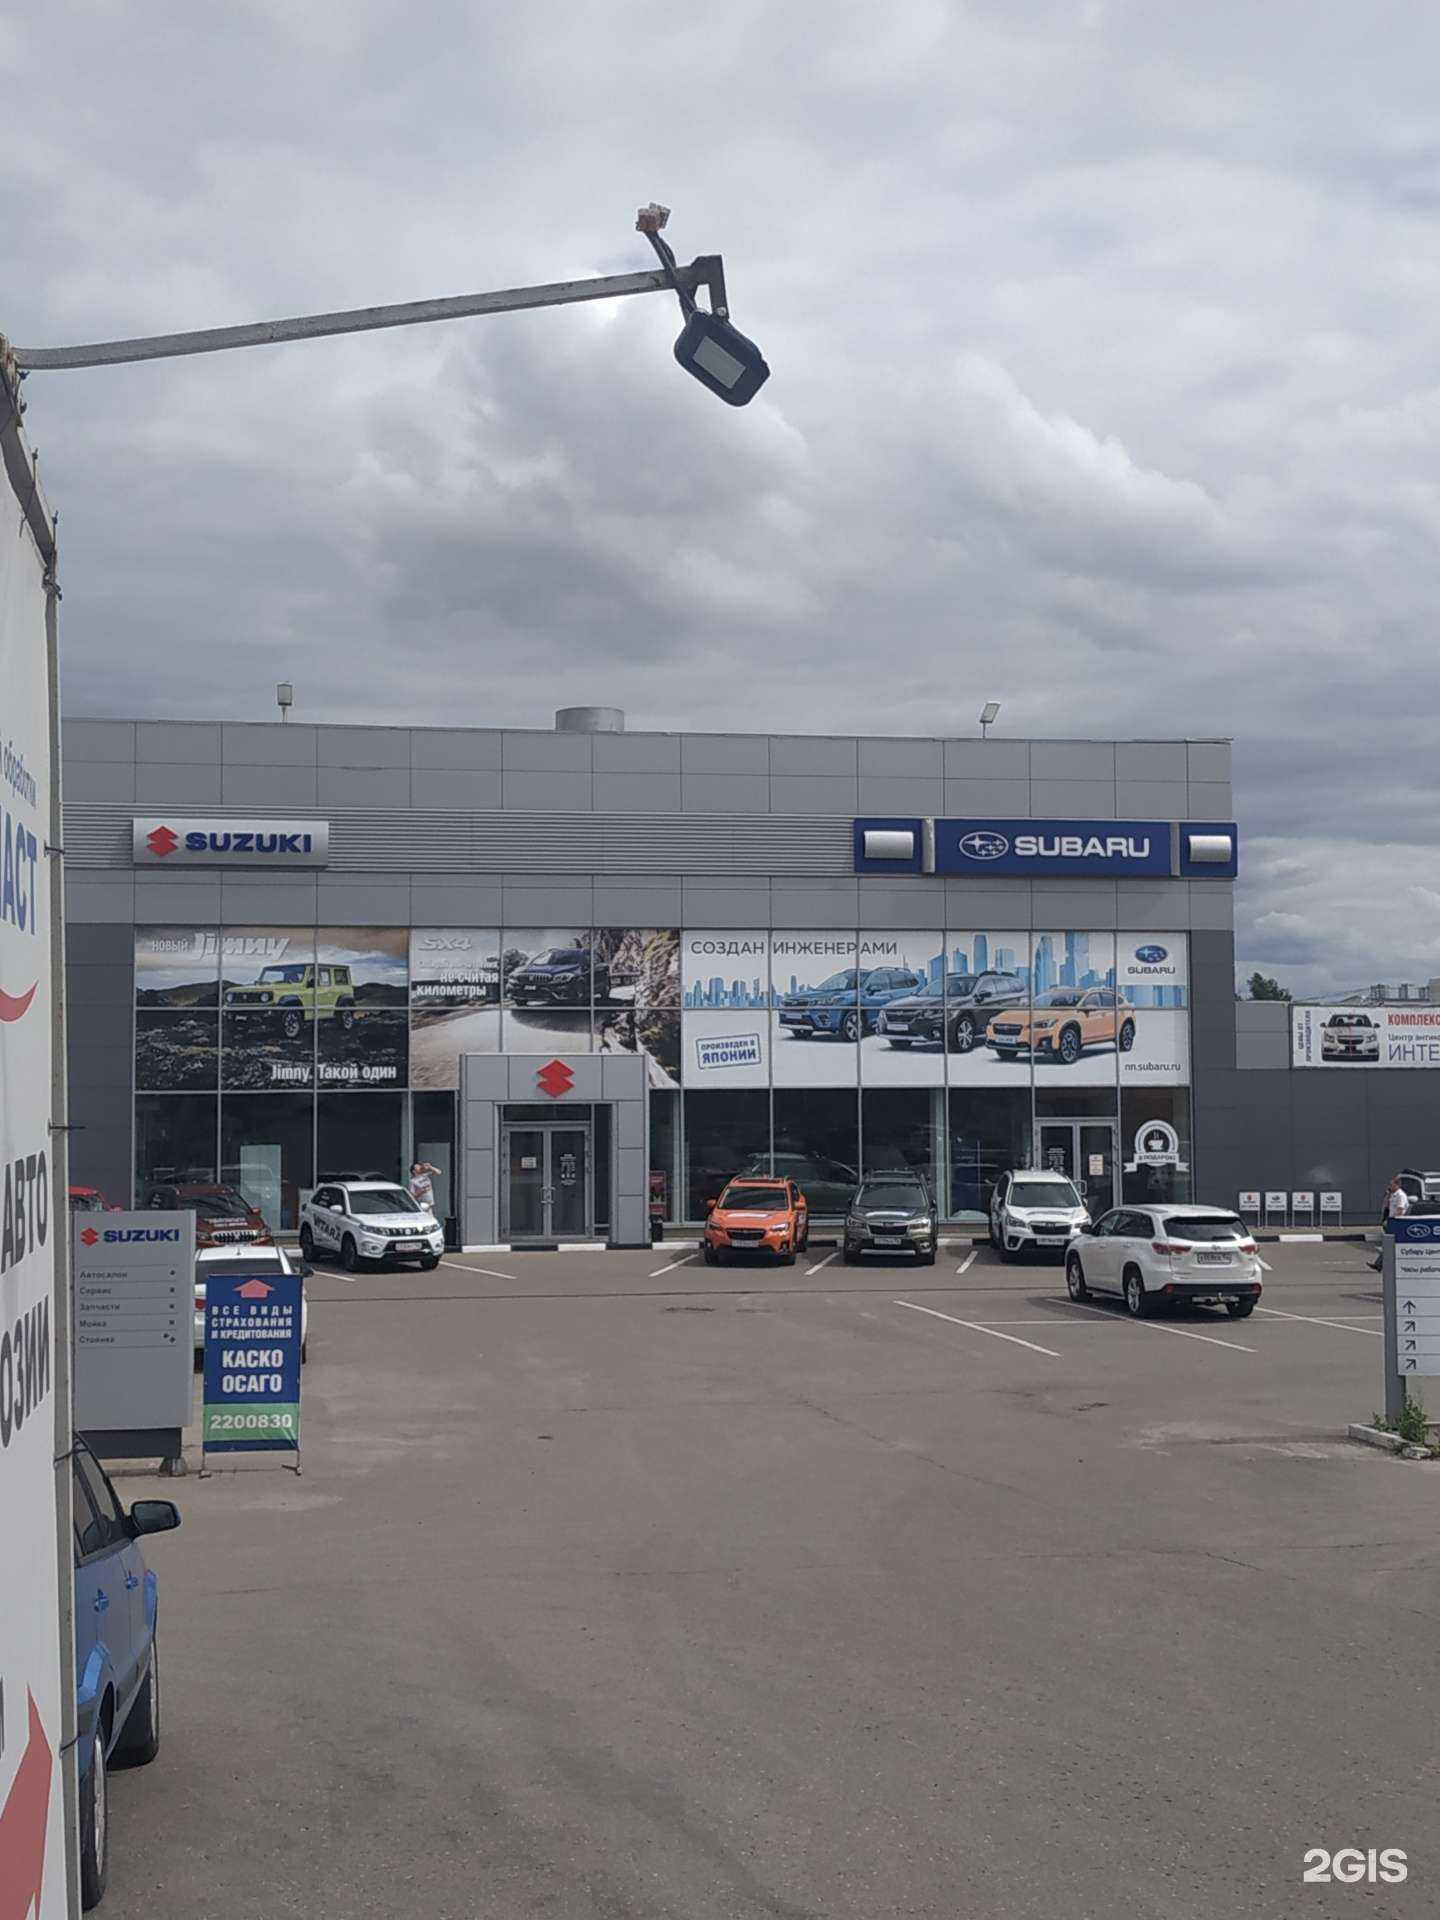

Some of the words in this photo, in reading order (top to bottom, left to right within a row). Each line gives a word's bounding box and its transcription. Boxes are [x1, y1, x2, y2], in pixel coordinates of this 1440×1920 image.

[185, 832, 312, 853] SUZUKI
[1014, 836, 1150, 858] SUBARU
[691, 941, 765, 957] СОЗДАН
[773, 941, 898, 956] ИНЖЕНЕРАМИ
[1127, 967, 1176, 975] SUBARU
[416, 985, 487, 998] километры
[702, 1048, 757, 1064] ЯПОНИИ
[1388, 1044, 1440, 1062] ИНТЕ
[317, 1063, 358, 1080] Такой
[362, 1065, 397, 1080] один
[1124, 1062, 1182, 1072] nn.subaru.ru
[1, 1149, 48, 1275] АВТО
[103, 1229, 180, 1243] SUZUKI
[80, 1271, 128, 1279] Автосалон
[212, 1305, 241, 1315] ВСЕ
[251, 1305, 293, 1316] ВИДЫ
[212, 1317, 293, 1328] СТРАХОВАНИЯ
[221, 1329, 293, 1341] КРЕДИТОВАНИЯ
[222, 1349, 284, 1368] КАСКО
[222, 1374, 282, 1393] ОСАГО
[210, 1413, 293, 1430] 2200830
